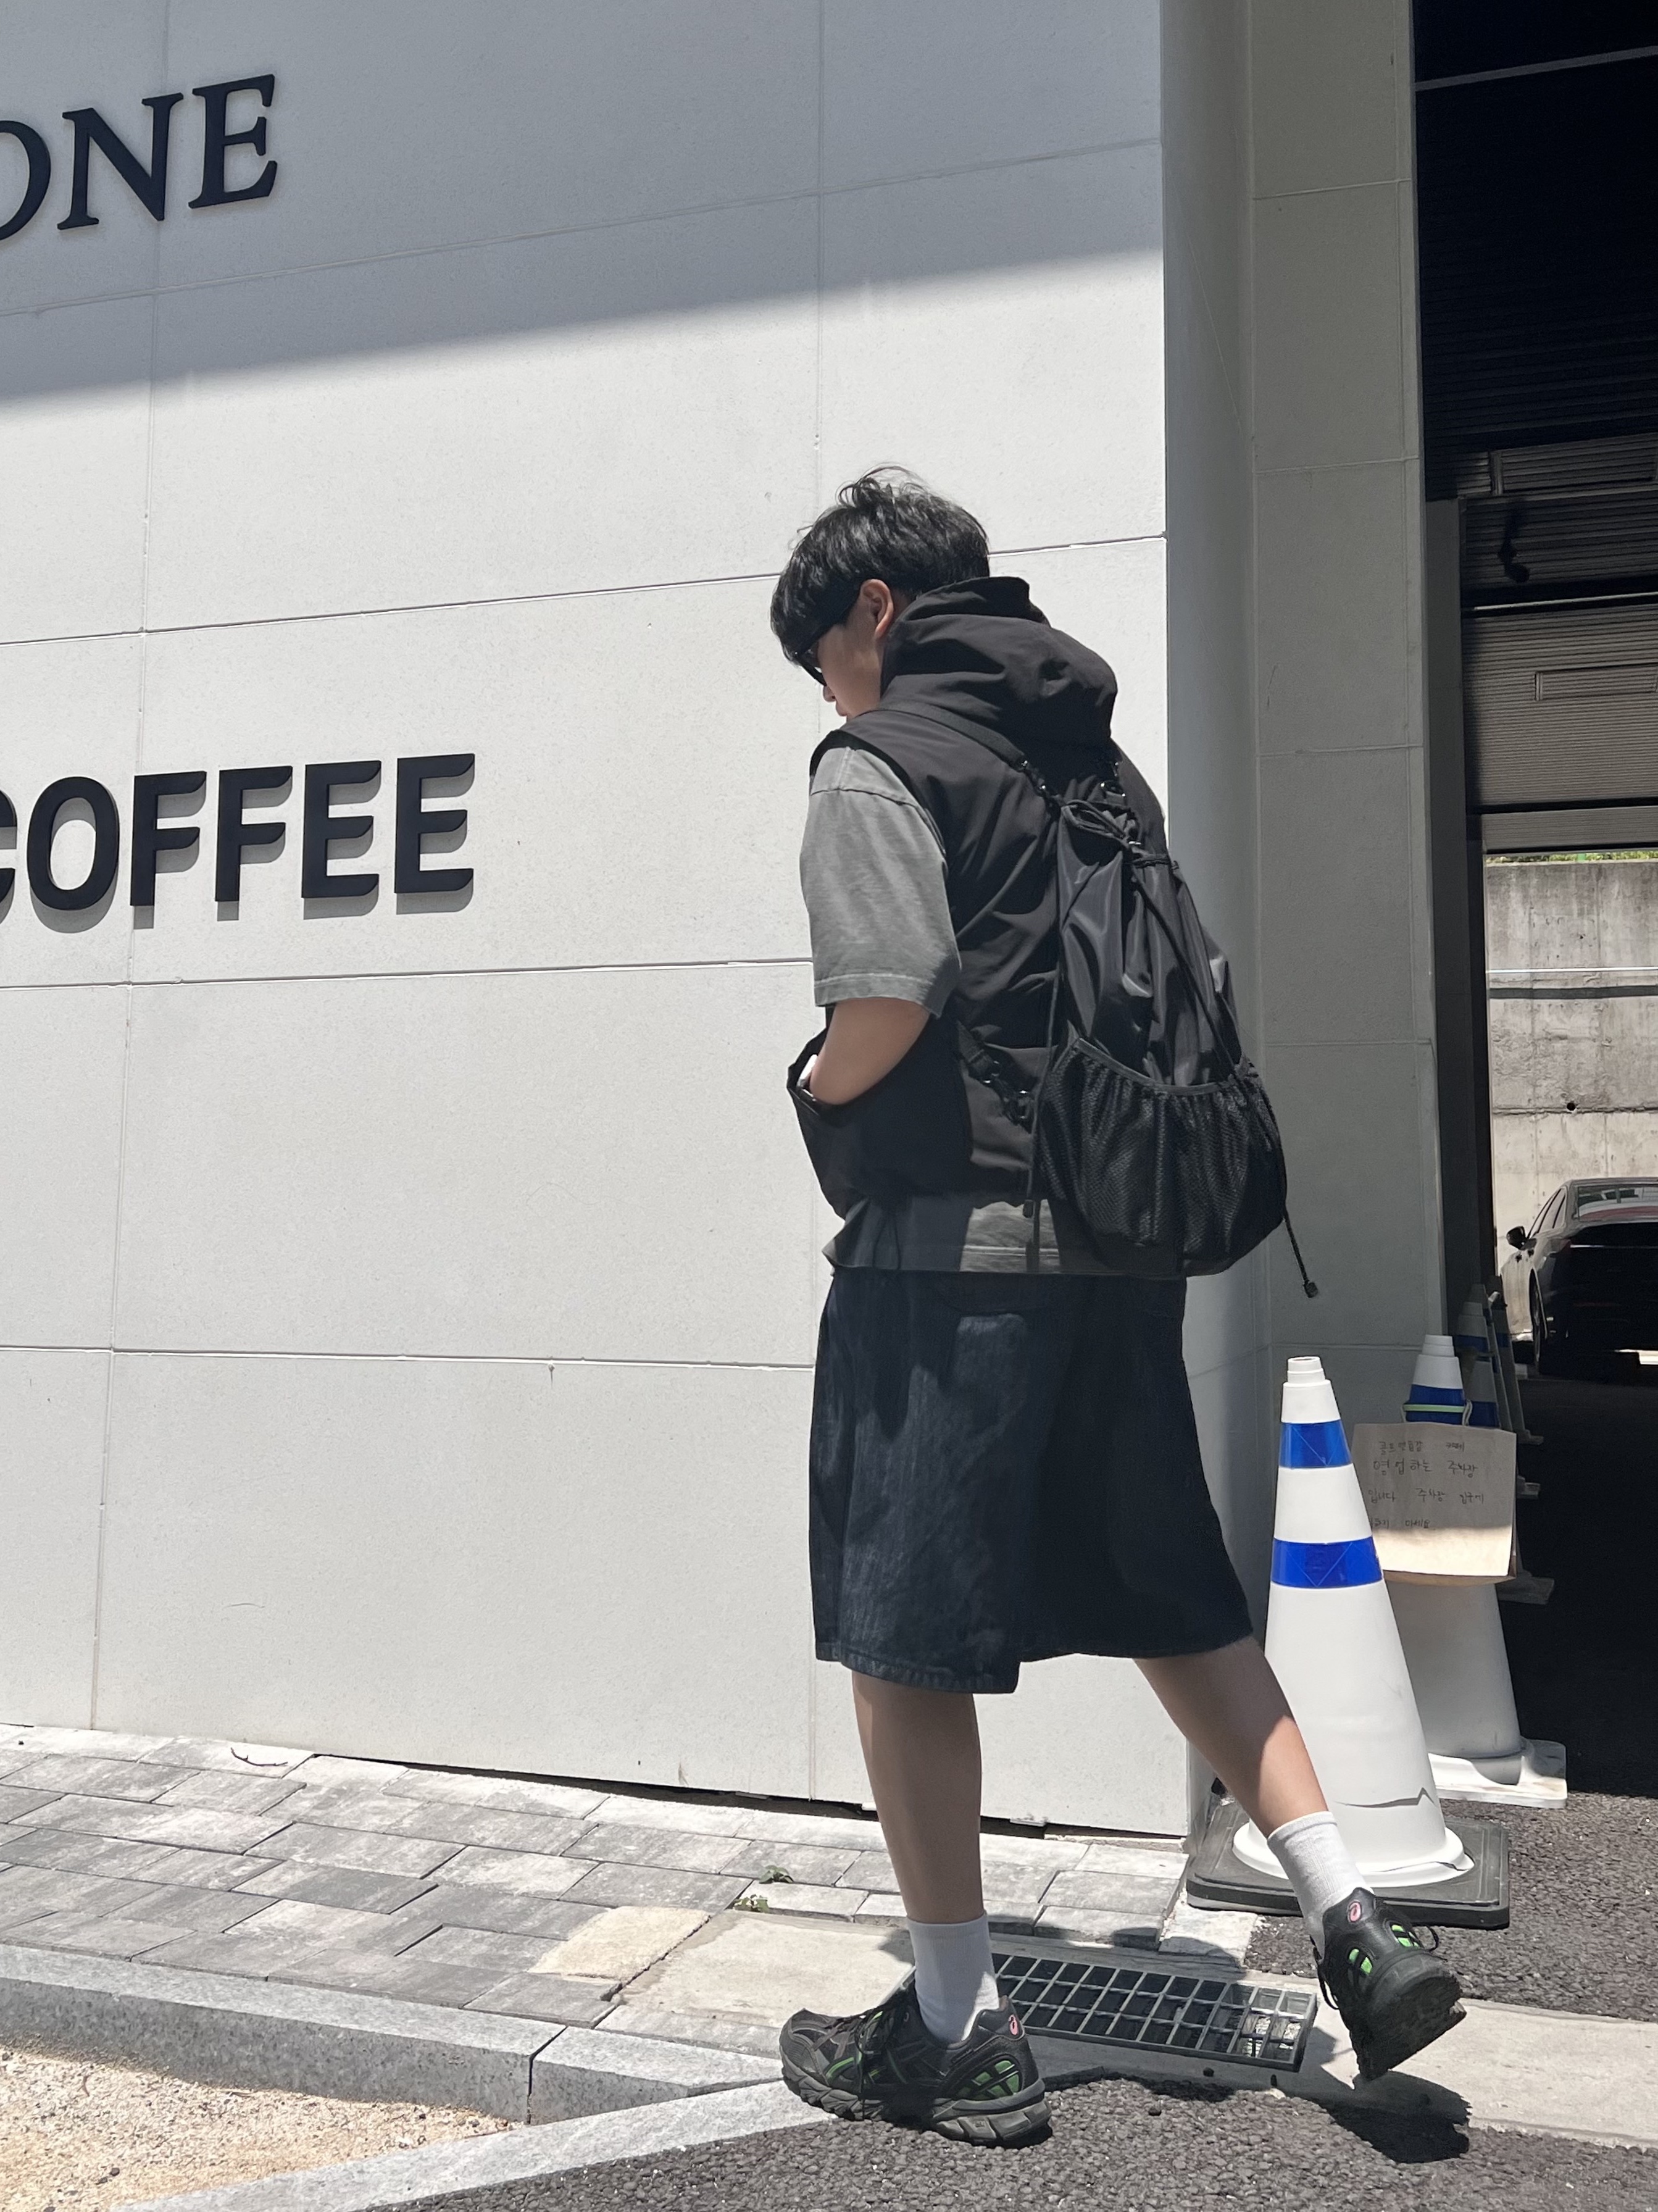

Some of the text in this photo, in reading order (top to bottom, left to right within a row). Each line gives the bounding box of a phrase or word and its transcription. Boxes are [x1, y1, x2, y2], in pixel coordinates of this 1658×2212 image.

[0, 753, 475, 914] OFFEE
[1447, 1459, 1479, 1478] 주차장
[1368, 1488, 1396, 1504] 입니다
[1415, 1487, 1446, 1503] 주차장
